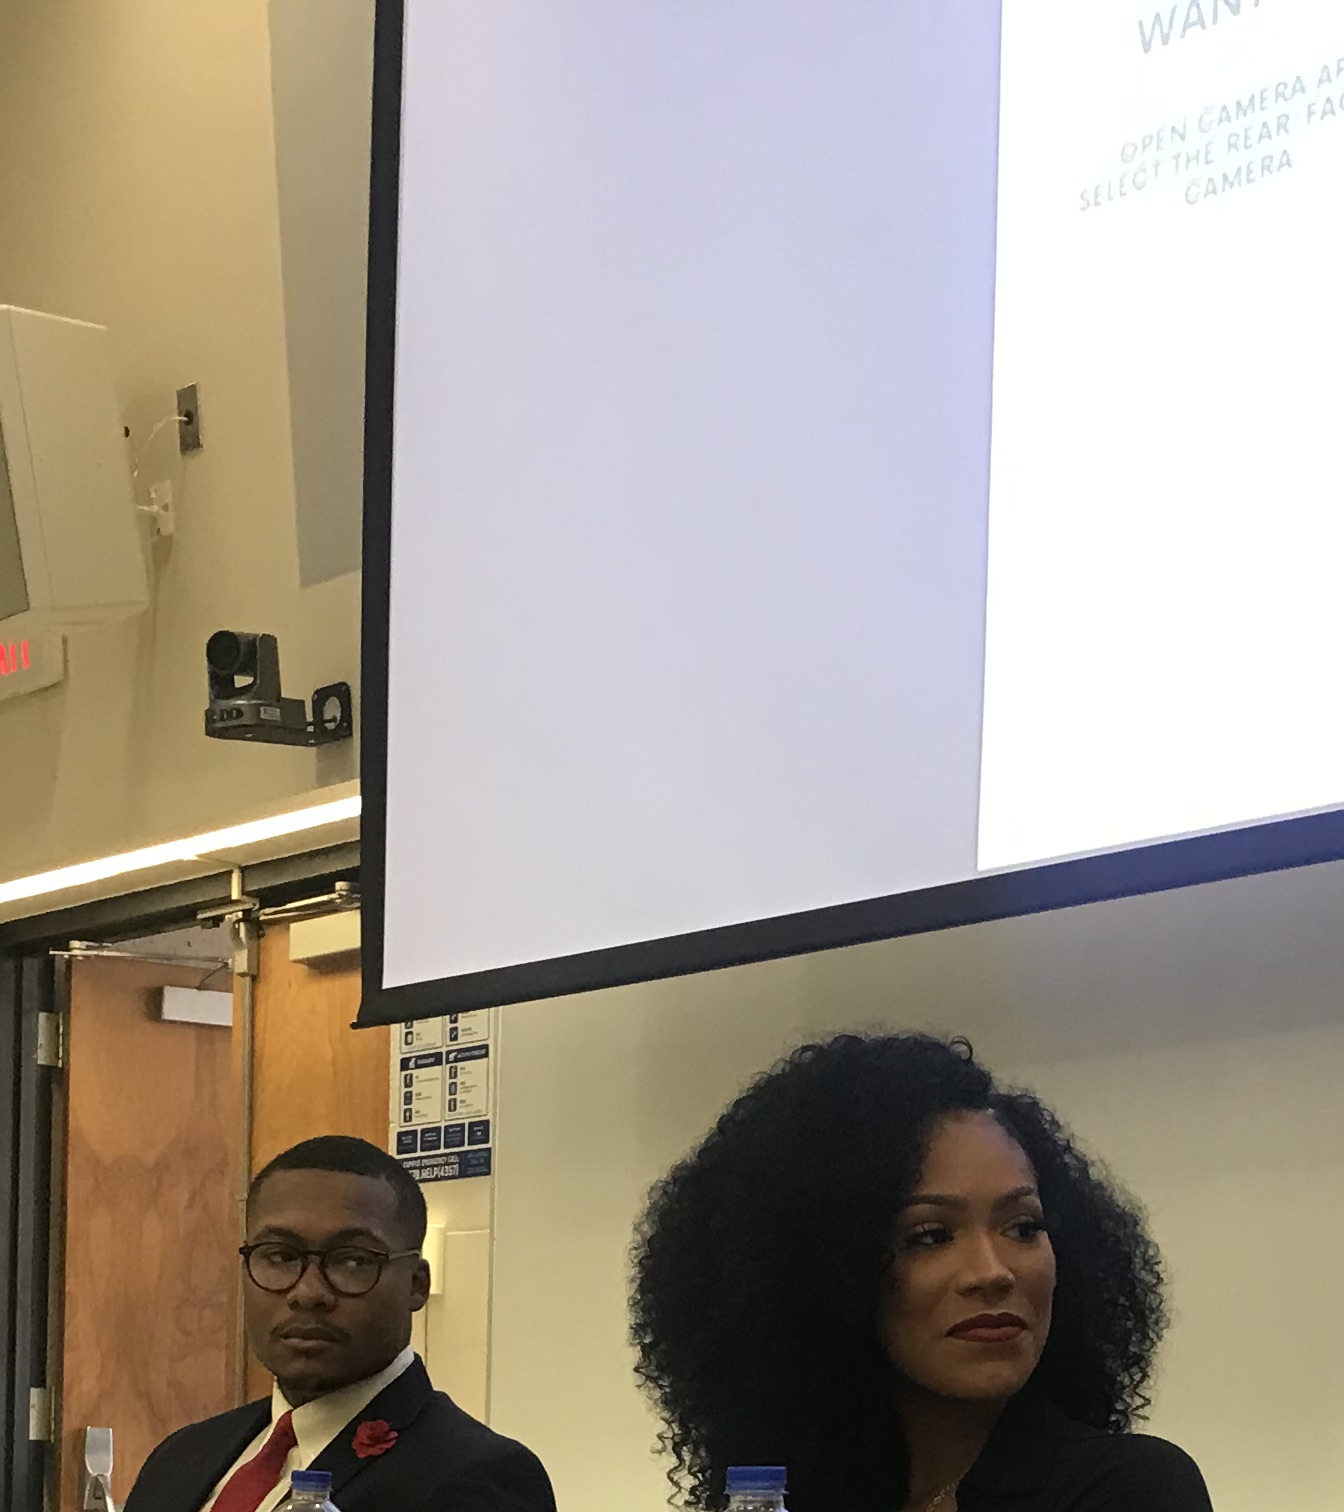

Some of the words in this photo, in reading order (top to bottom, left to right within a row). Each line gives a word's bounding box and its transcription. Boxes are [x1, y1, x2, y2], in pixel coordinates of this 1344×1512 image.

[1138, 0, 1261, 54] WAN
[1120, 115, 1187, 164] OPEN
[1197, 75, 1306, 134] CAMERA
[1079, 158, 1162, 212] SELECT
[1172, 139, 1214, 175] THE
[1227, 113, 1290, 155] REAR
[1185, 149, 1294, 206] CAMERA
